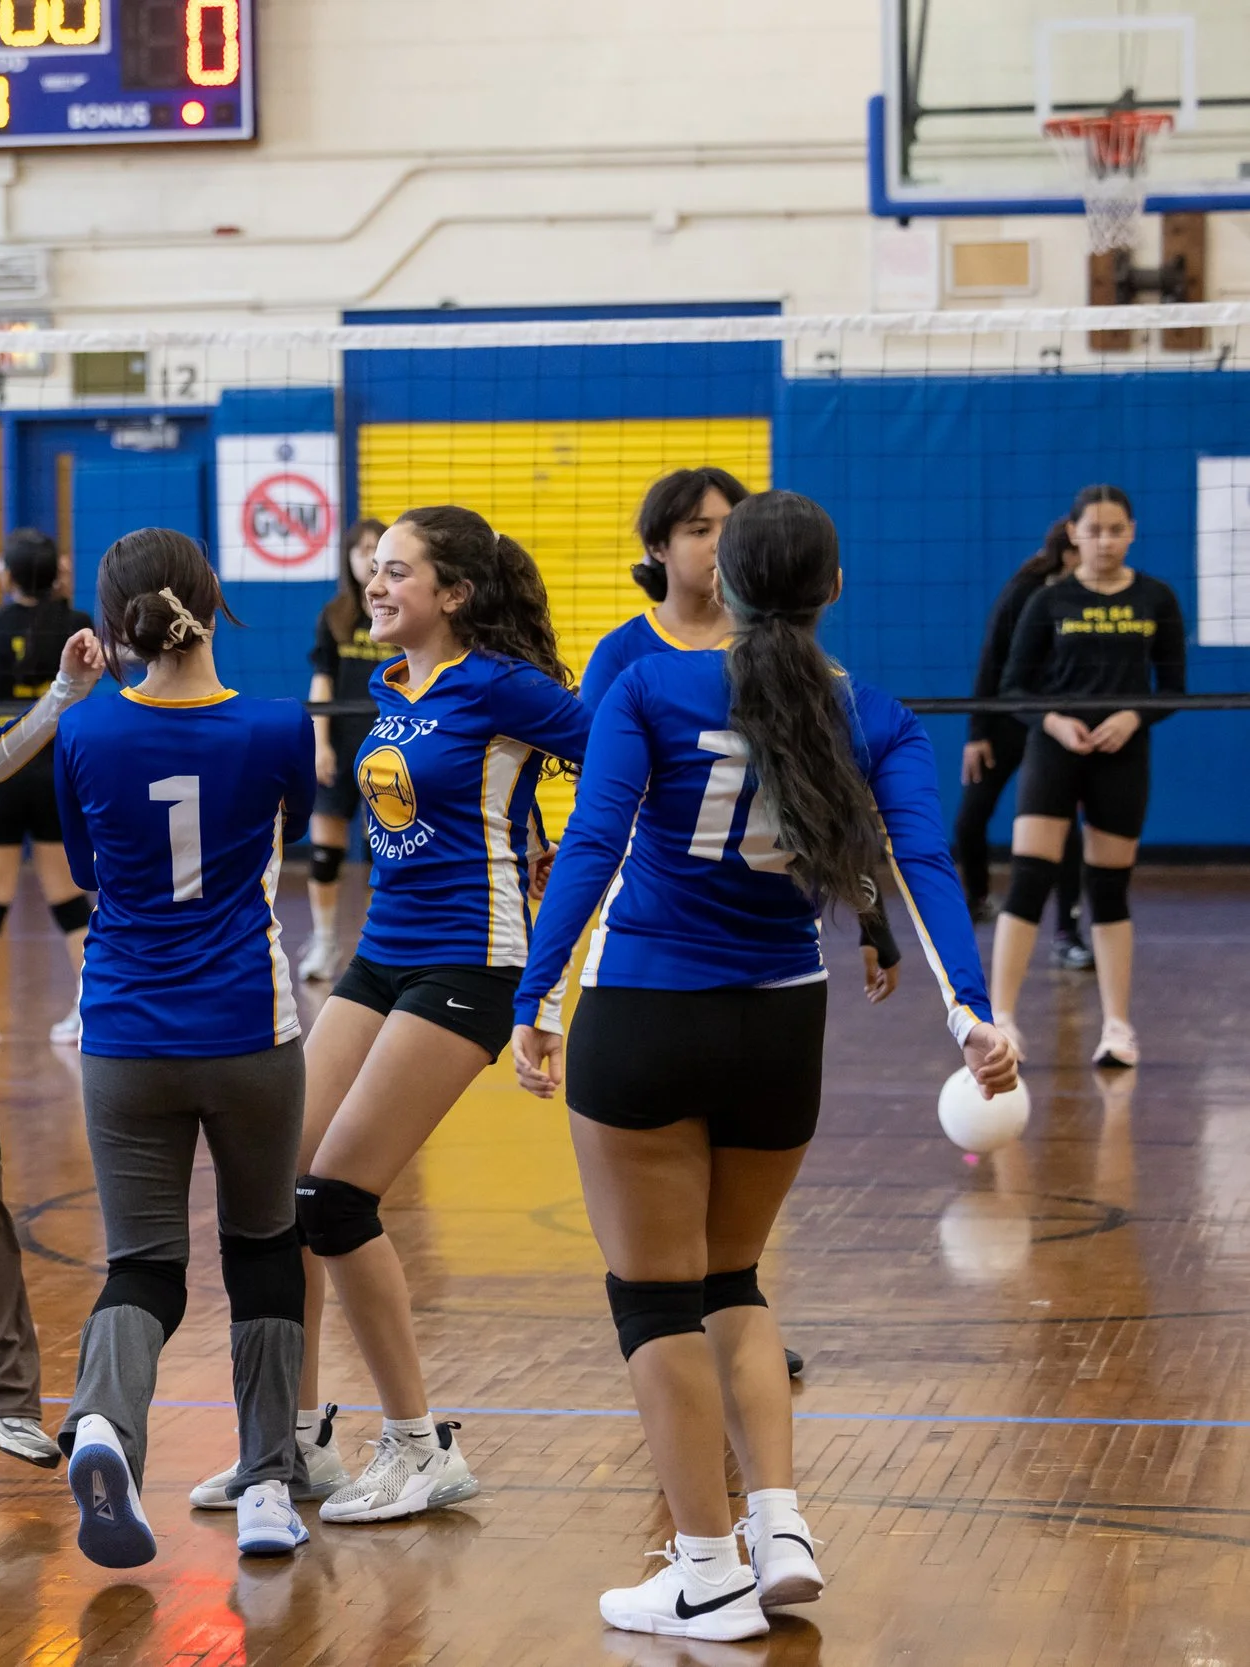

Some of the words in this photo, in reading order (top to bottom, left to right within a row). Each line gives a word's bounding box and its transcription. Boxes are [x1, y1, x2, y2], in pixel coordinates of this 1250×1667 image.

[186, 0, 240, 87] 0
[66, 102, 150, 130] BONUS
[161, 364, 196, 399] 12
[369, 715, 407, 741] MS
[148, 775, 203, 902] 1
